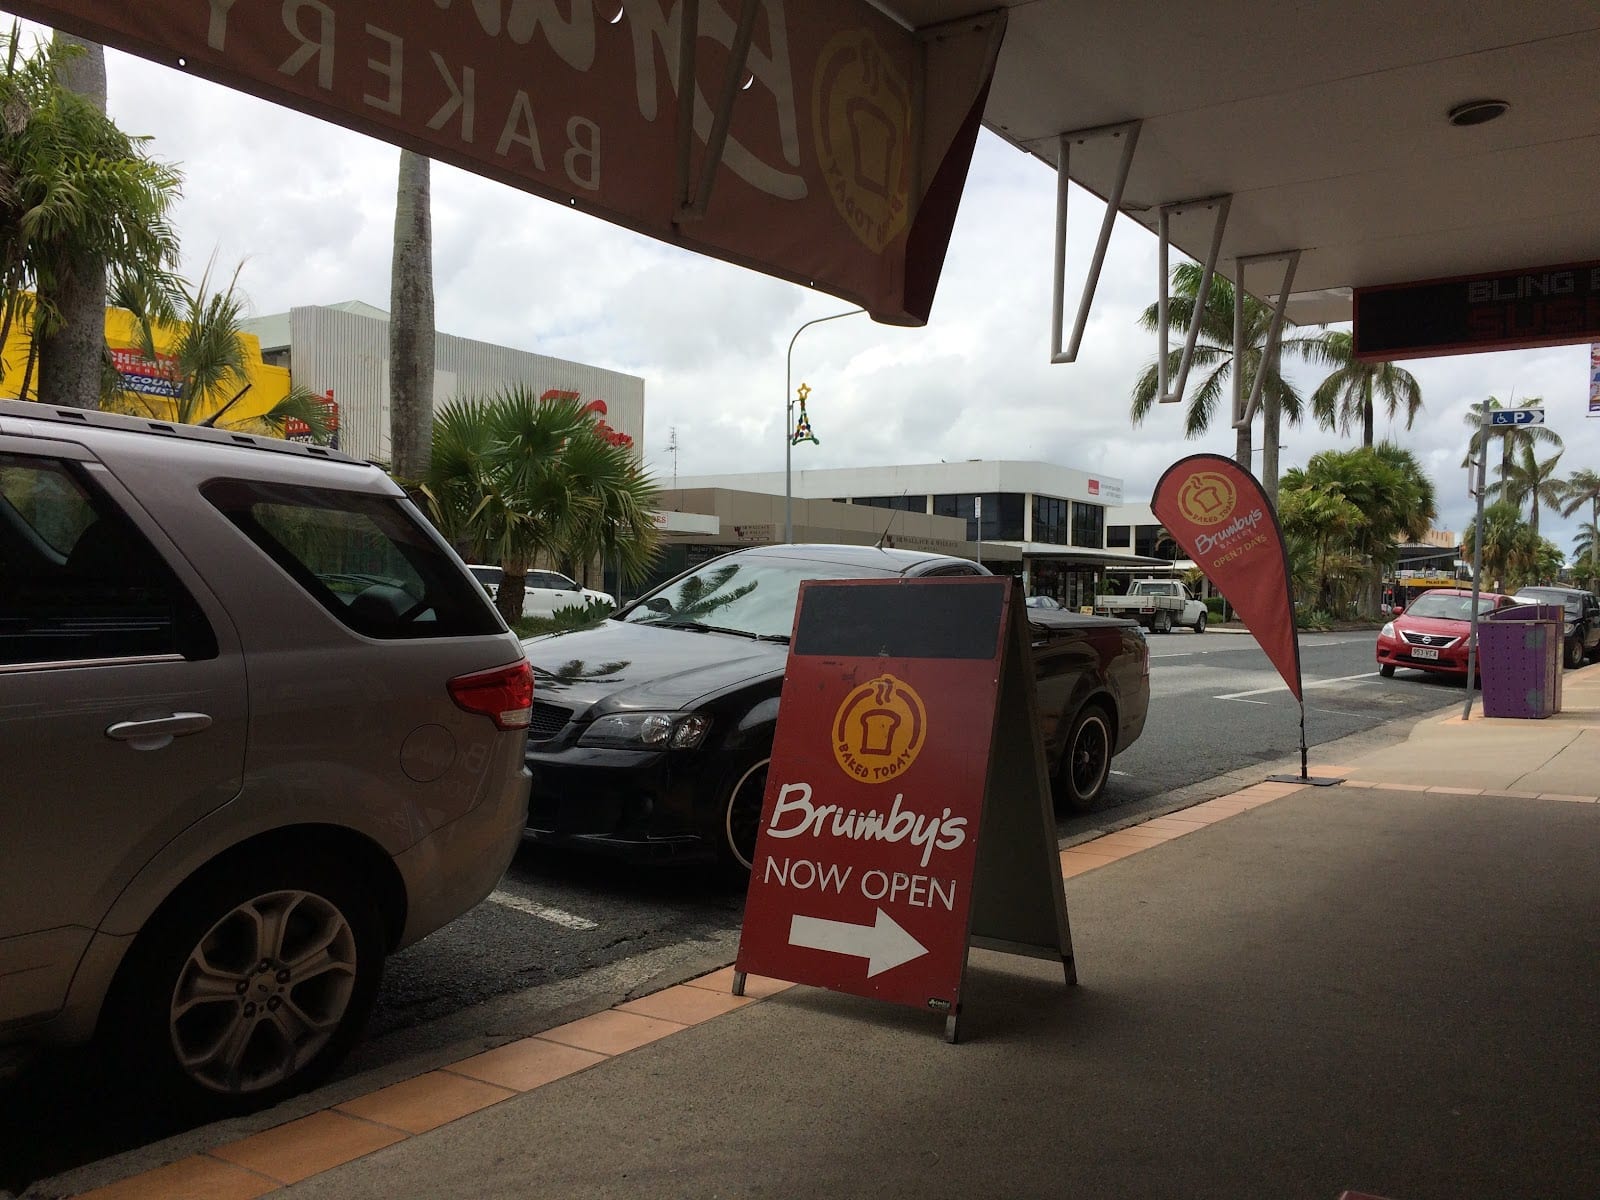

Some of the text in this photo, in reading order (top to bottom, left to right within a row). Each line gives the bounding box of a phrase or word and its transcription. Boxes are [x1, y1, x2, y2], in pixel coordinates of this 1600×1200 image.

[1468, 271, 1575, 303] BLING
[1514, 412, 1525, 423] P
[1195, 508, 1263, 555] Brumby's
[1213, 549, 1238, 567] OPEN
[1244, 534, 1267, 551] DAYS
[838, 743, 911, 779] BAKED TODAY
[767, 783, 968, 867] Brumby's
[764, 855, 957, 911] NOW OPEN
